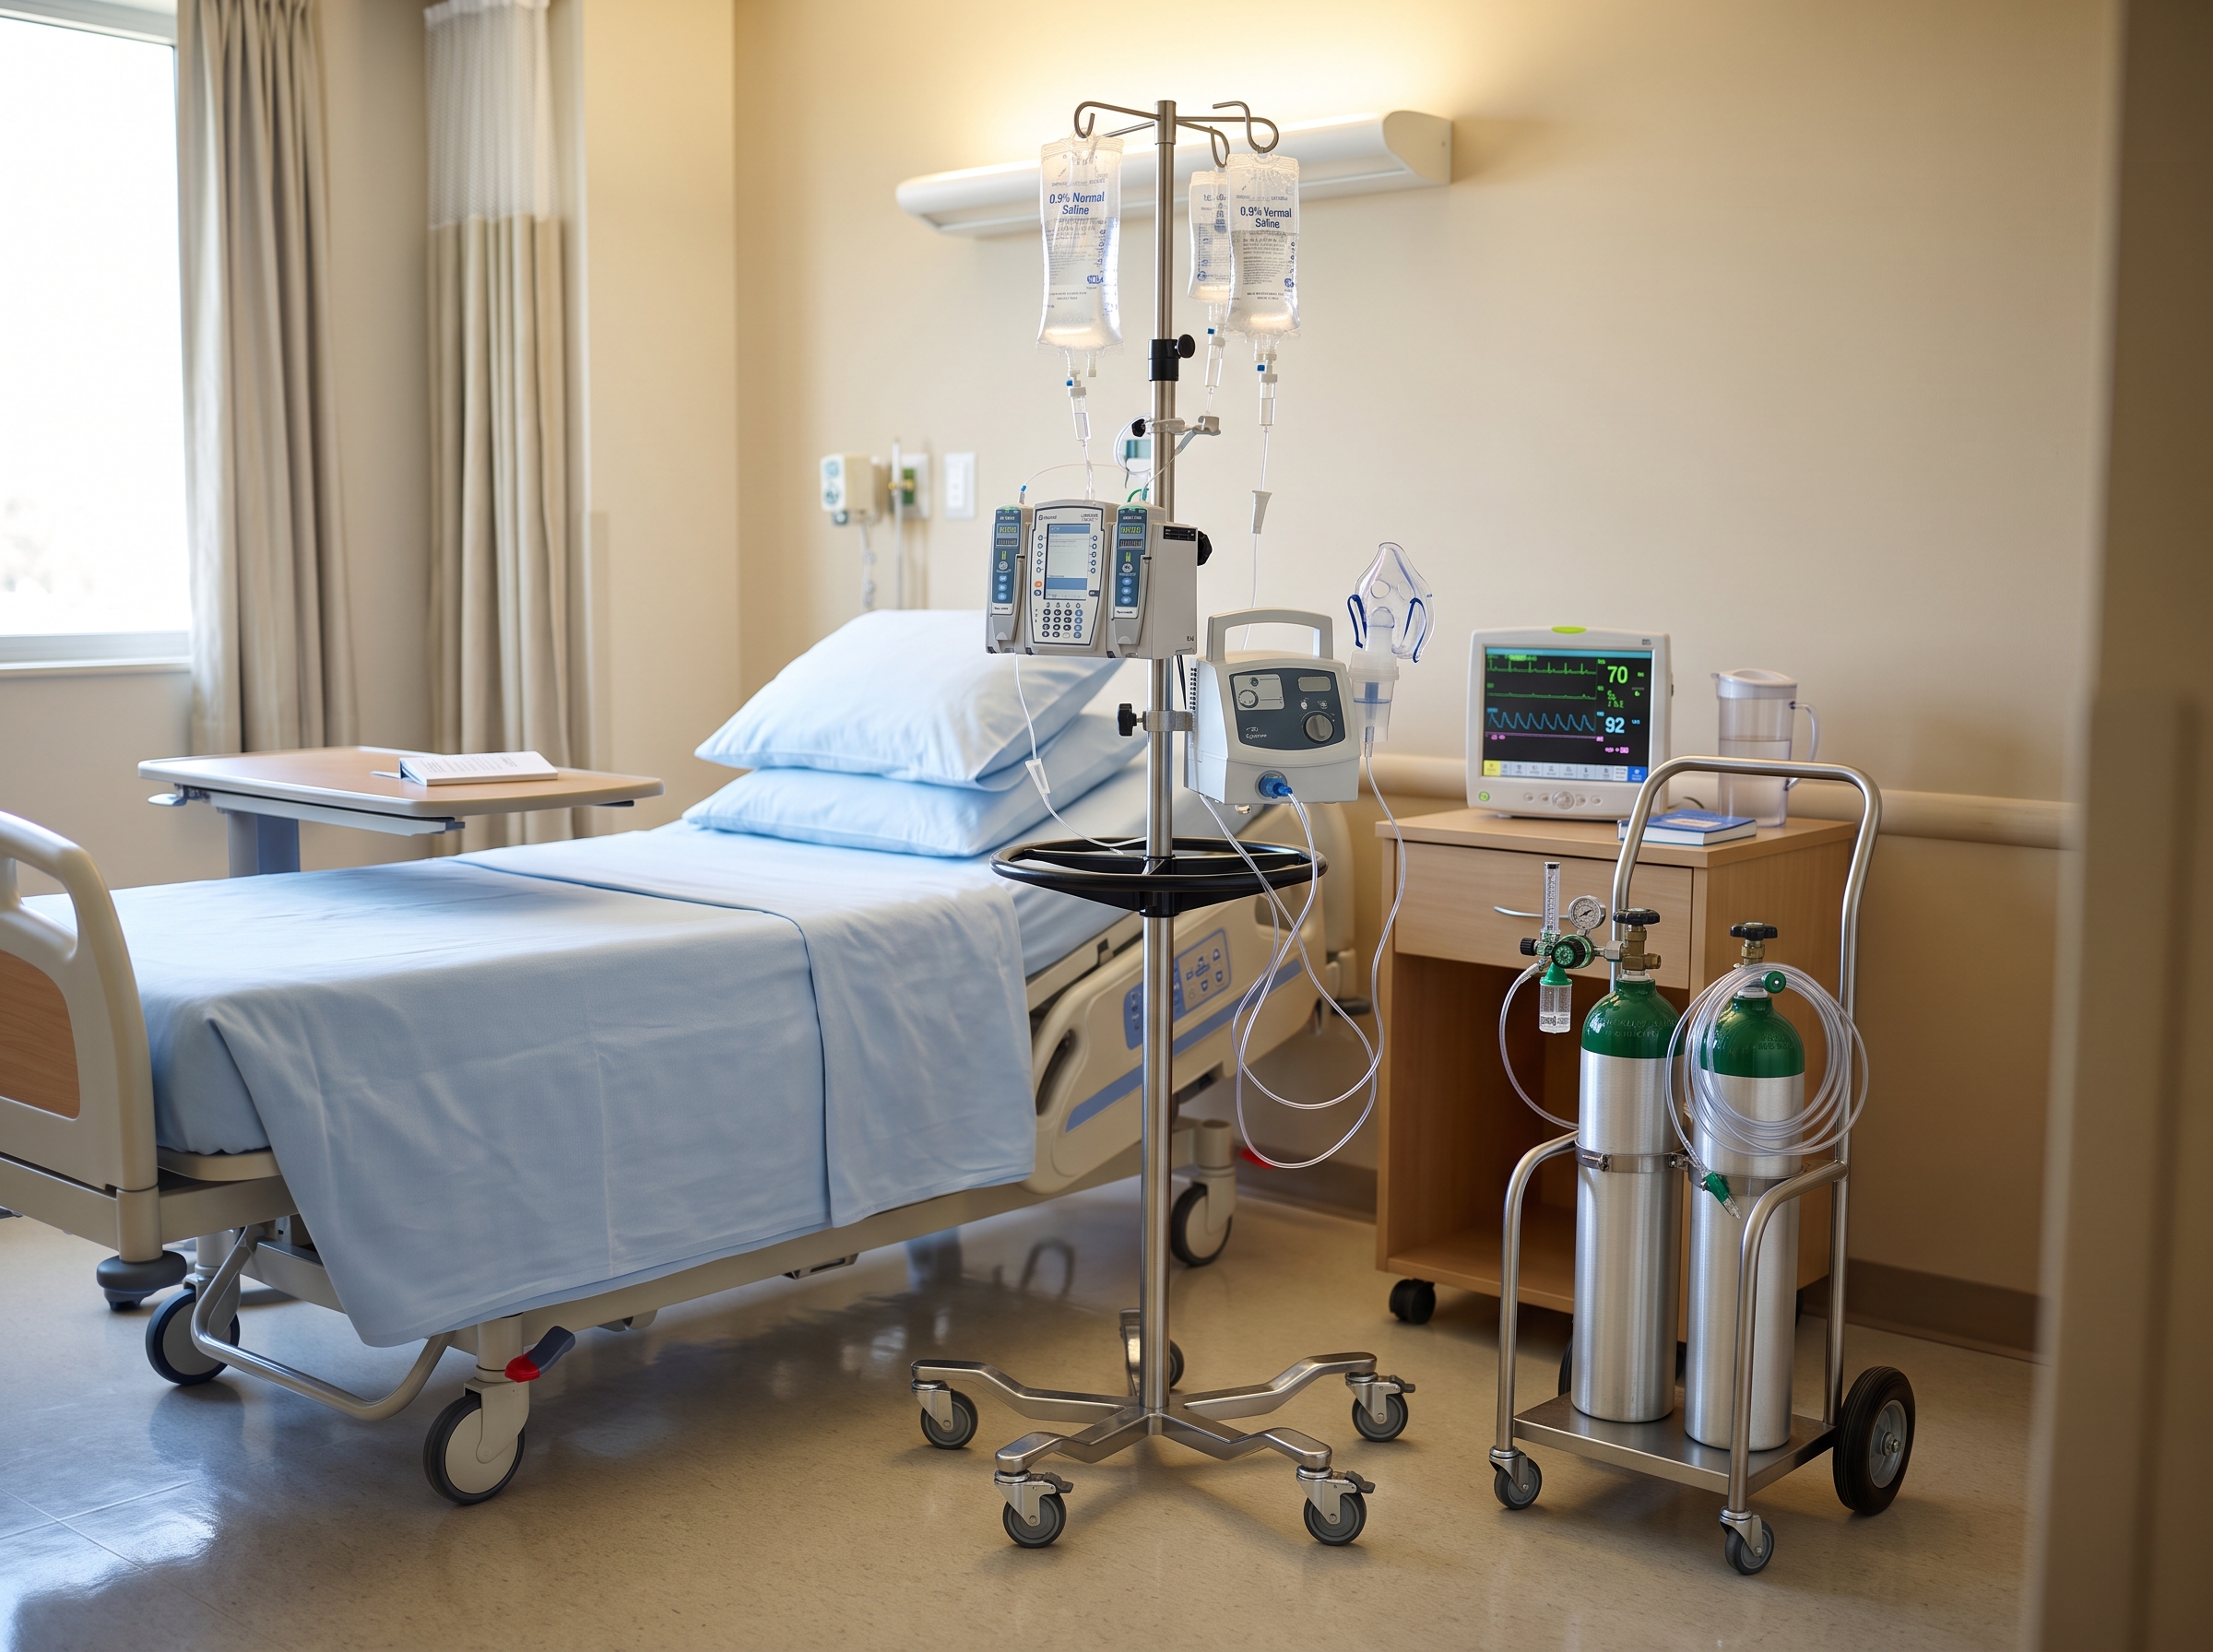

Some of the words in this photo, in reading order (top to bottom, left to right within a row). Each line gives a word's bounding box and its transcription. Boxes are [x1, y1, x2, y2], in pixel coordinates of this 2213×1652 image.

[1049, 193, 1071, 204] 0.9%
[1062, 205, 1090, 215] Saline
[1240, 206, 1262, 217] 0.9%
[1255, 218, 1281, 229] Saline
[1607, 666, 1628, 684] 70
[1605, 716, 1626, 734] 92
